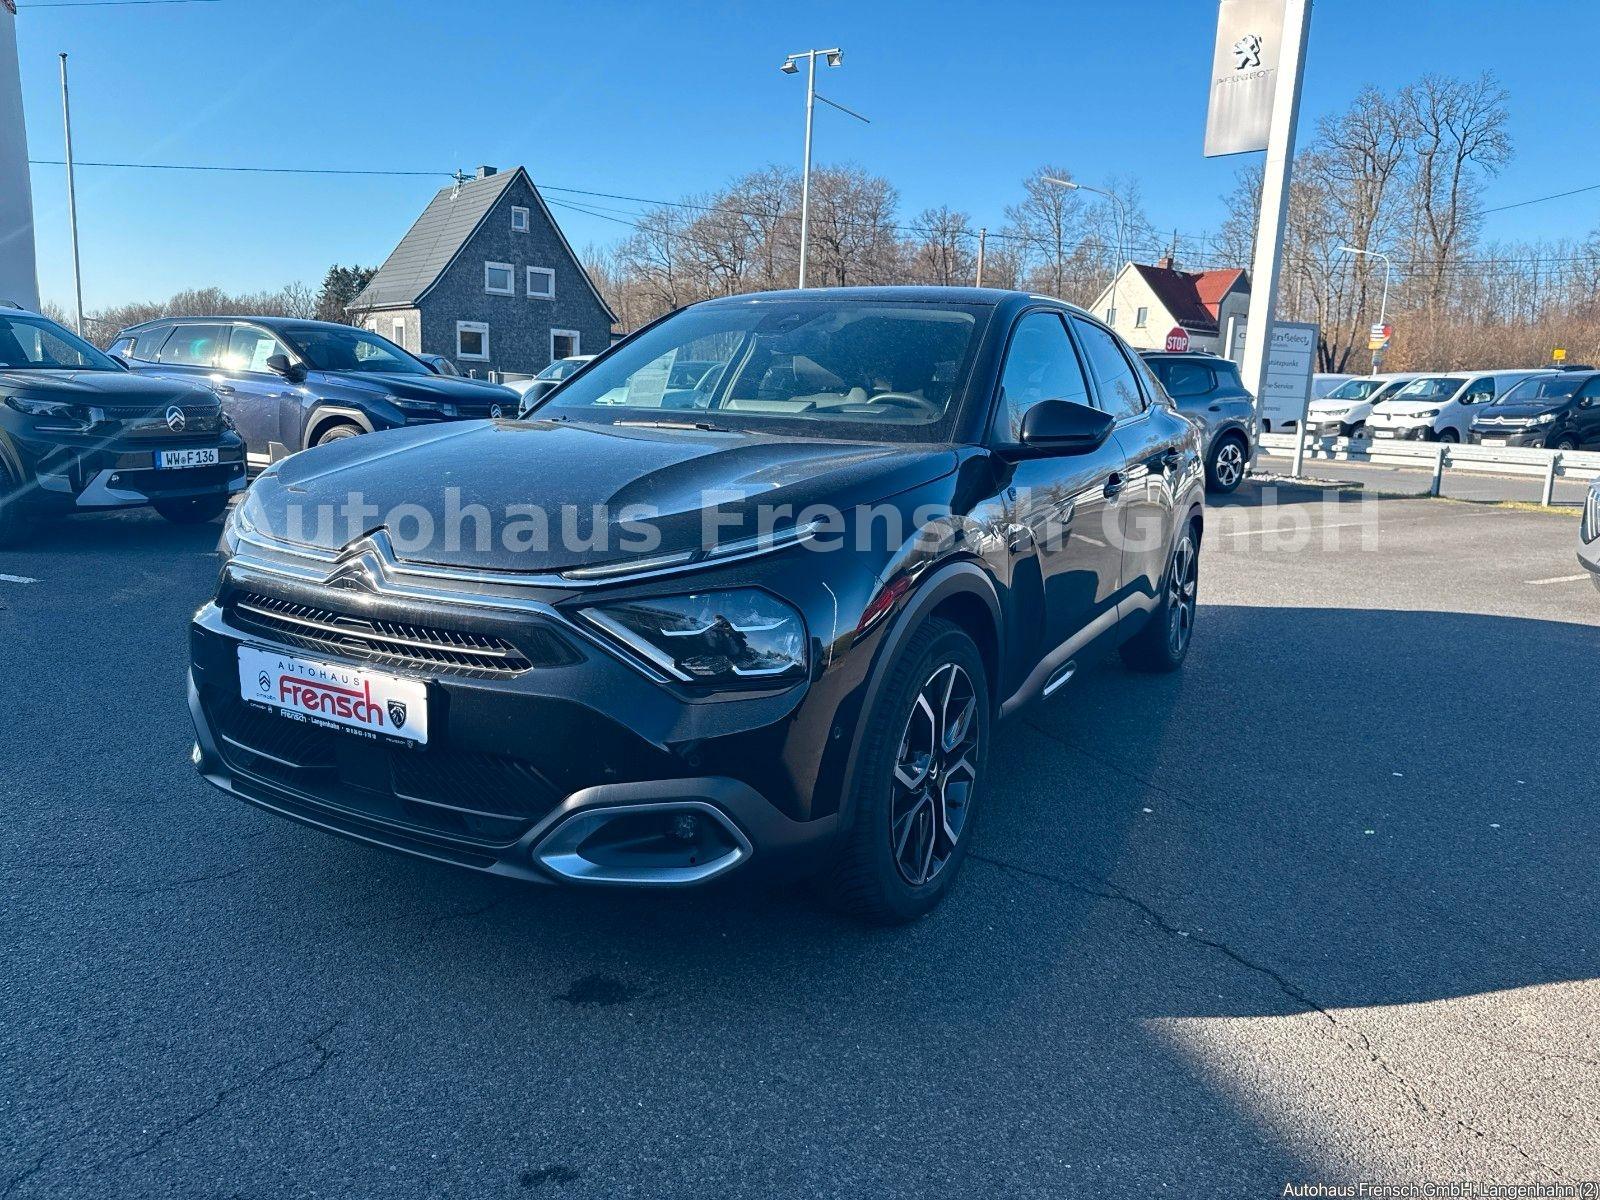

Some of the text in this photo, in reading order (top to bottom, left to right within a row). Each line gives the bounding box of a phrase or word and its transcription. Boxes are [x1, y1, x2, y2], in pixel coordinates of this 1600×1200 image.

[1166, 336, 1188, 350] STOP
[278, 661, 360, 686] AUTOHAUS
[279, 674, 384, 726] Frensch
[281, 709, 307, 724] Frensch
